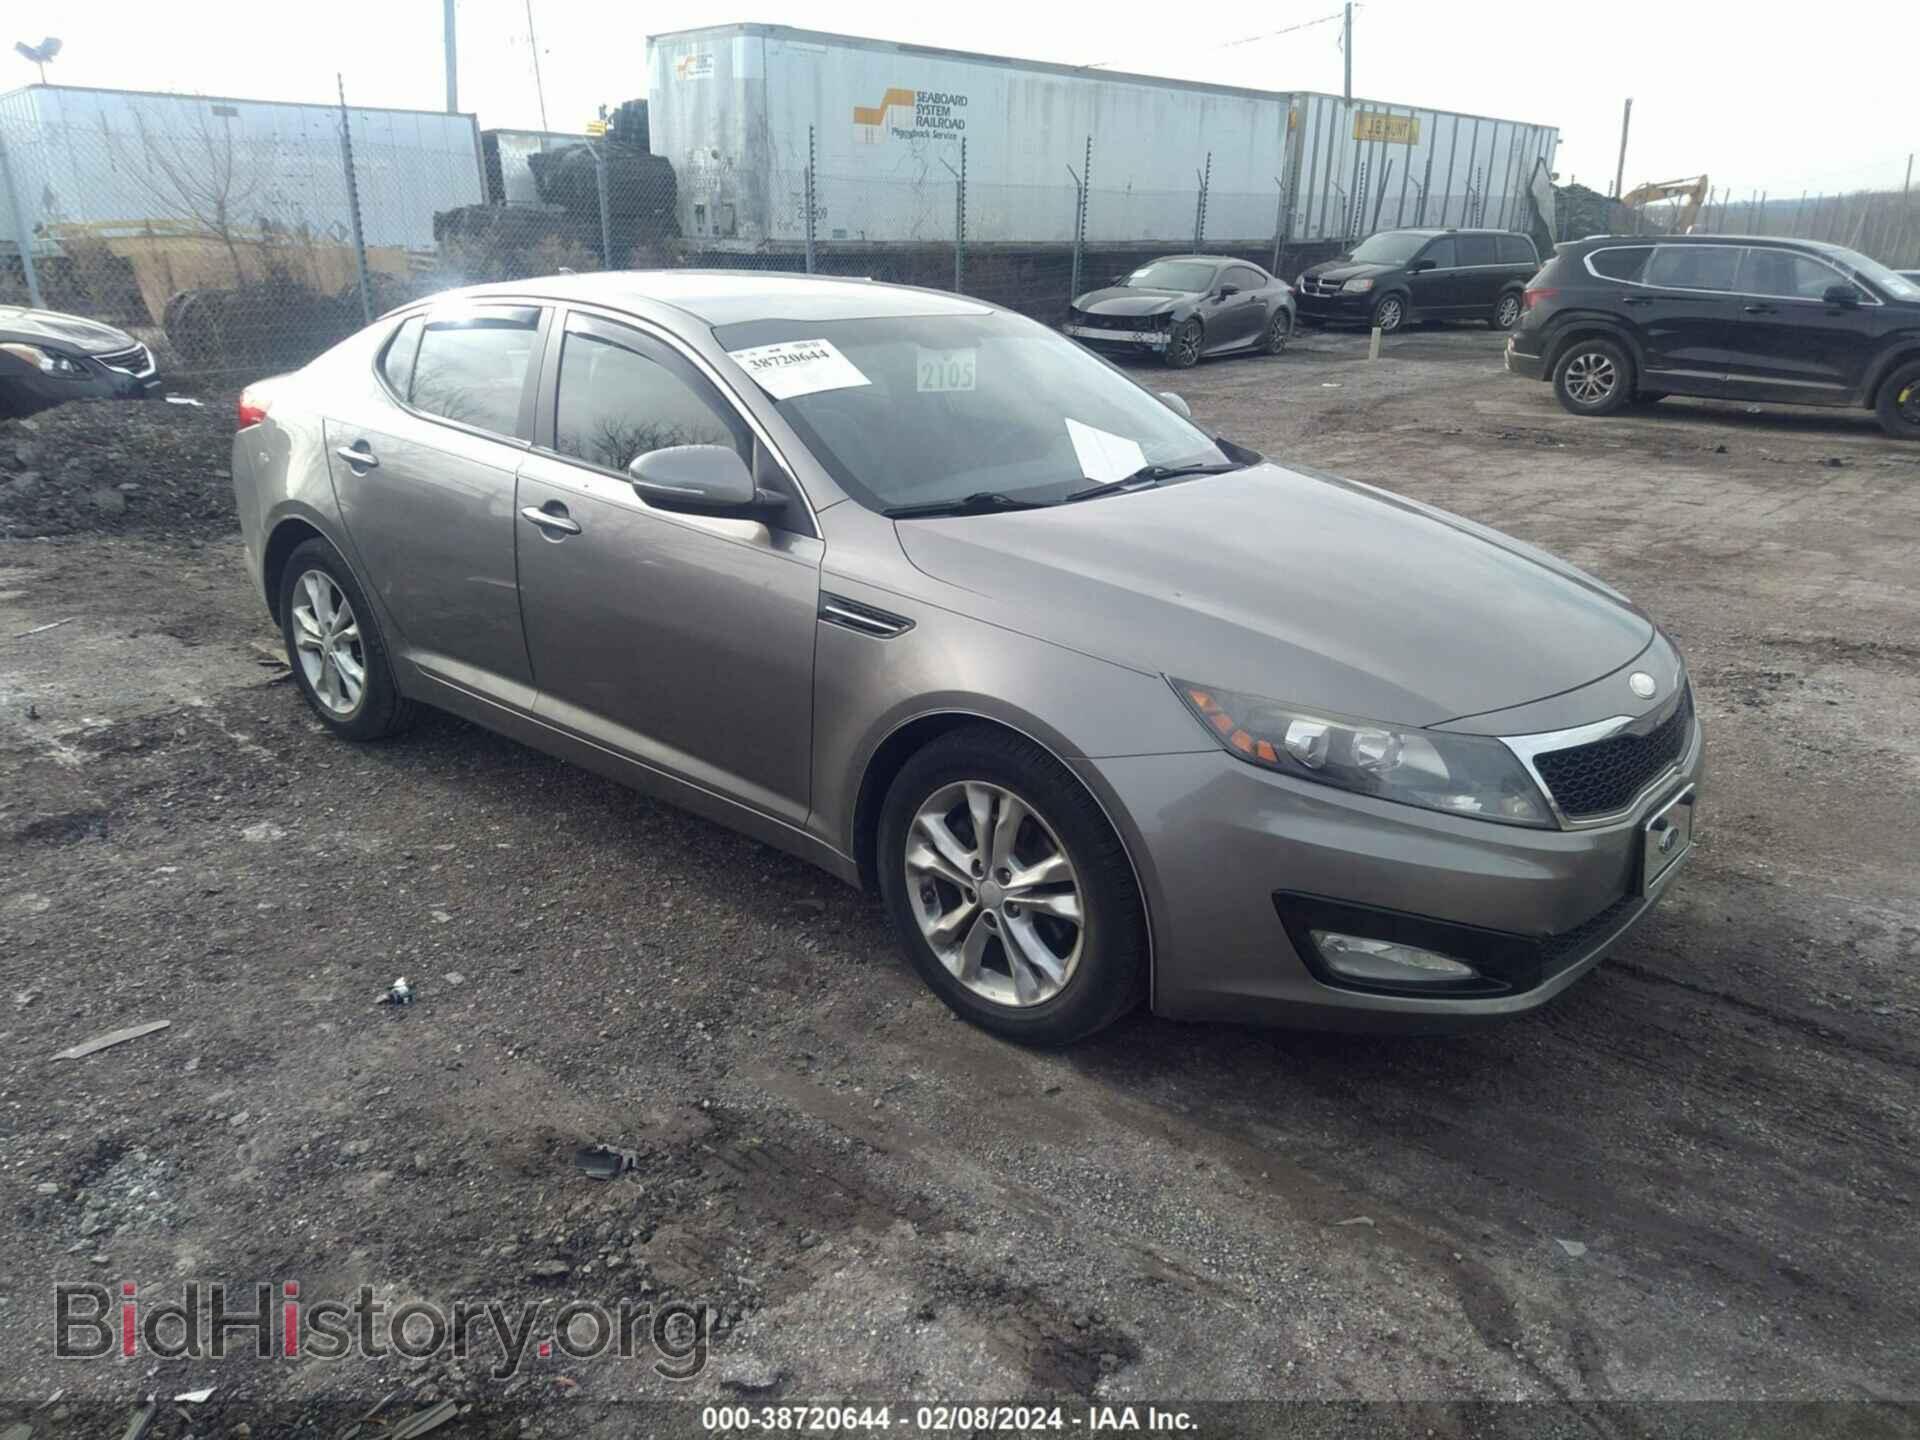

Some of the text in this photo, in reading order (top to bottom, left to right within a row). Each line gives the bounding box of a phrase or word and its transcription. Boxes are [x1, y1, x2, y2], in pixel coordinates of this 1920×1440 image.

[916, 91, 968, 106] SEABOARD
[916, 103, 951, 117] SYSTEM
[916, 116, 965, 130] RAILROAD
[1384, 119, 1409, 137] HUNT
[891, 127, 957, 140] Piggyback Service
[748, 349, 831, 370] 38720644
[920, 361, 973, 389] 2105
